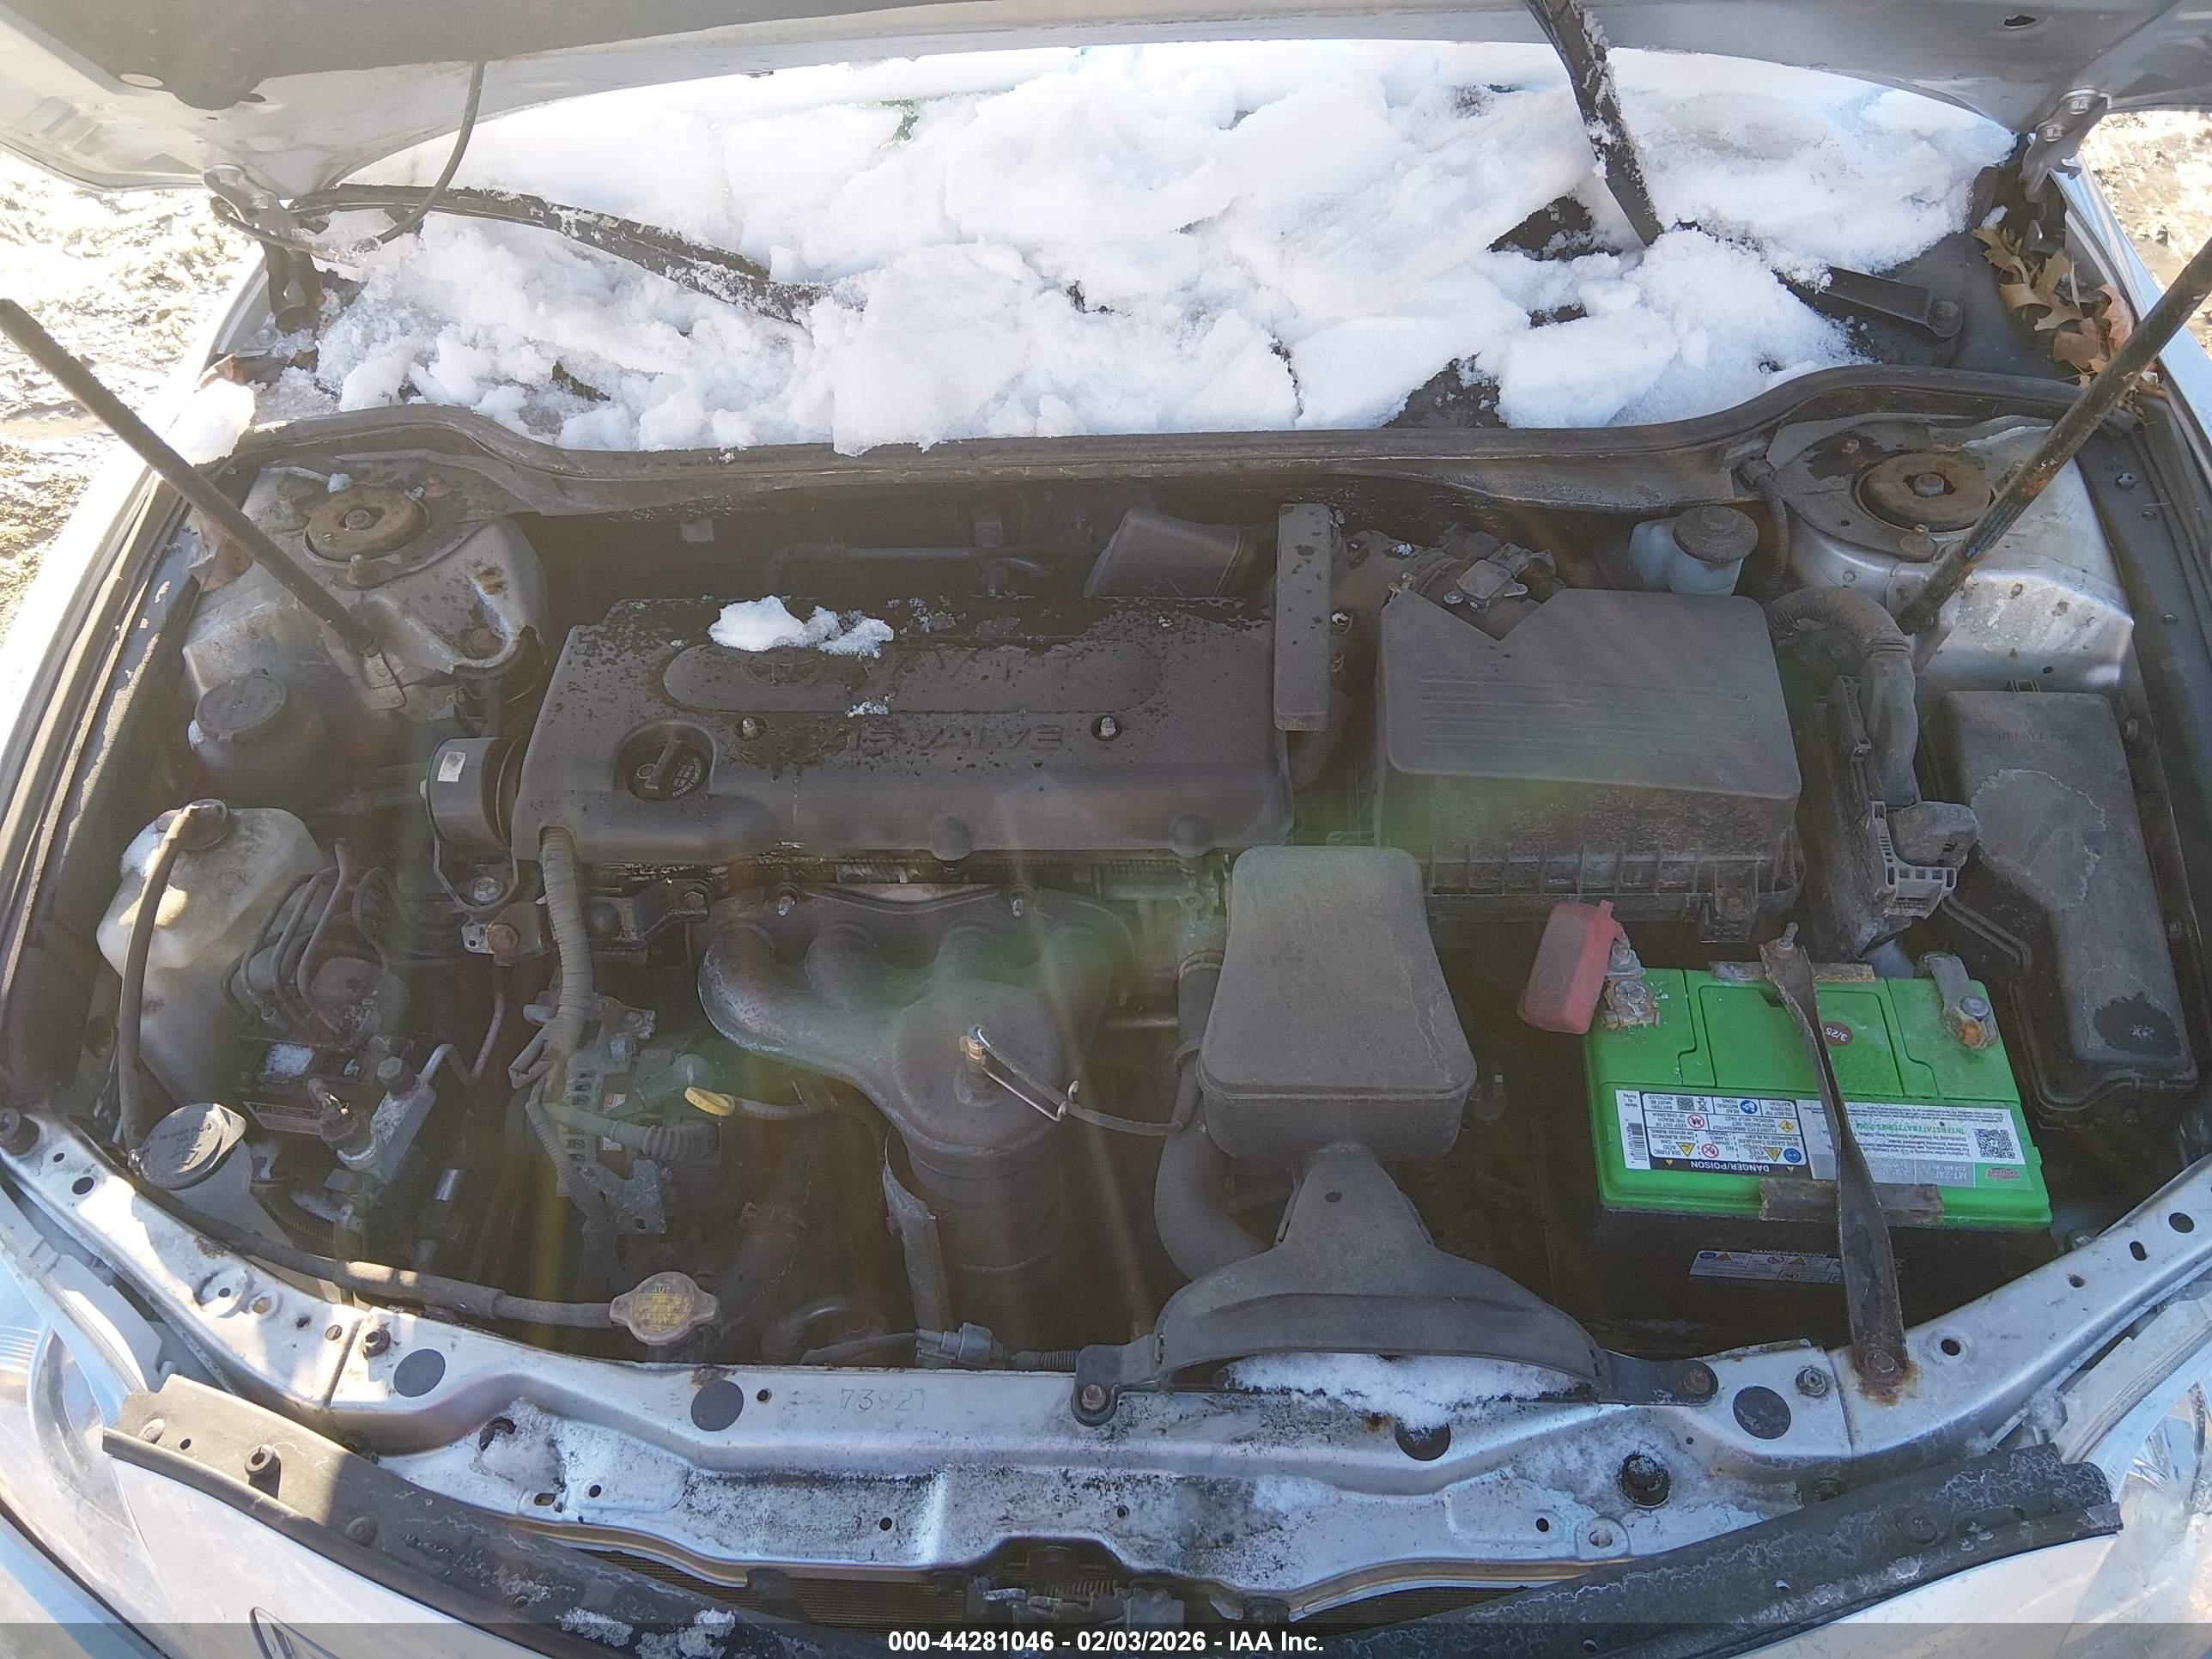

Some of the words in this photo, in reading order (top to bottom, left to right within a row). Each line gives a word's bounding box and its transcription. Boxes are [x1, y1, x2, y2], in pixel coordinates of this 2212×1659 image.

[907, 726, 1064, 754] VALVE
[1826, 1027, 1847, 1042] 3/25
[1691, 1161, 1770, 1173] DANGER/POISON
